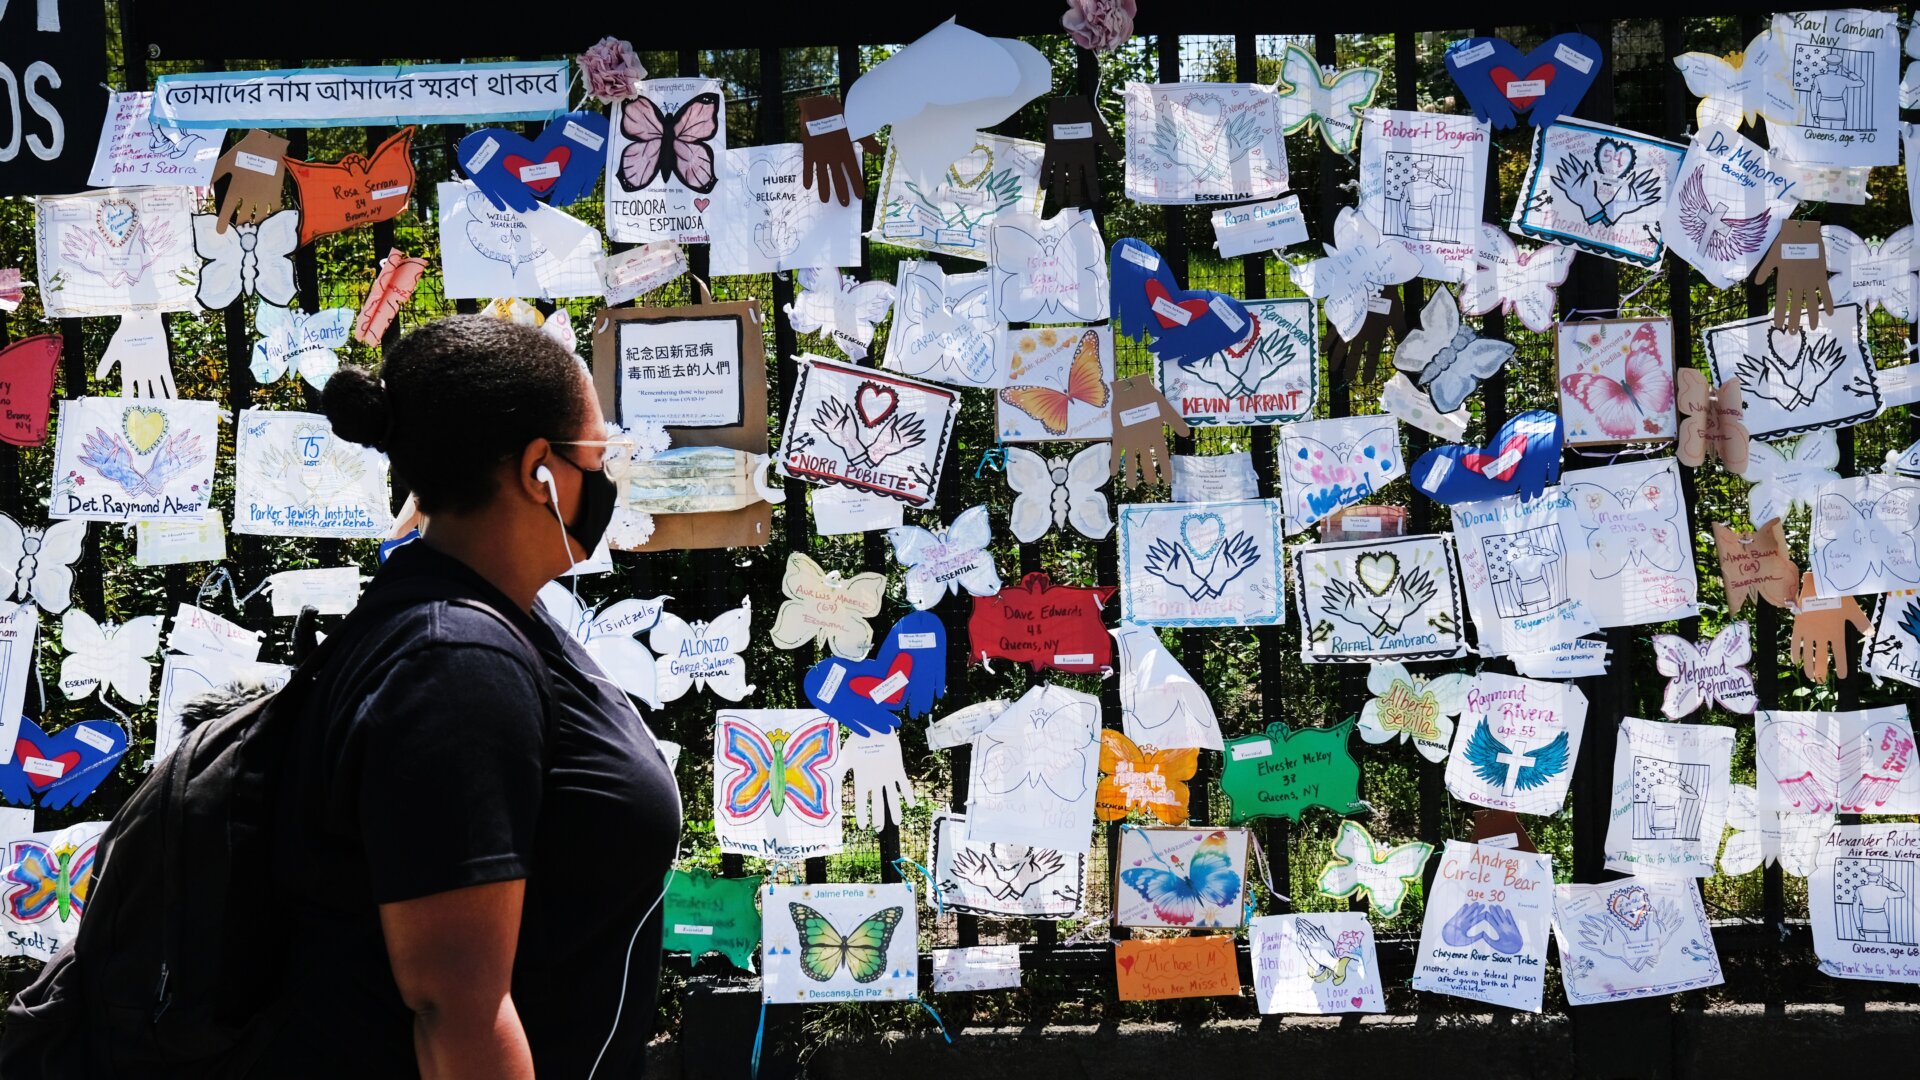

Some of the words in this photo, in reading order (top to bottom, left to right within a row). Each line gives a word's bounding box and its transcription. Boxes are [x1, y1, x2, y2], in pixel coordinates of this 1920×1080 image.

[1793, 12, 1827, 34] Raul
[1834, 18, 1884, 40] Cambian
[1810, 33, 1840, 48] Navy
[166, 80, 262, 106] তোমাদের
[268, 81, 311, 104] নাম
[316, 77, 415, 102] আমাদের
[419, 74, 478, 99] স্মরণ
[488, 70, 560, 96] থাকবে
[1382, 119, 1432, 140] Robert
[1838, 132, 1855, 144] age
[1858, 132, 1876, 143] 70
[112, 163, 134, 174] John
[1603, 149, 1624, 169] 54
[763, 175, 797, 184] HUBERT
[1720, 163, 1757, 188] Brooklyn
[1729, 143, 1797, 200] Mahoney
[332, 186, 359, 200] Rosa
[364, 180, 398, 193] Serrano
[756, 192, 797, 202] BELGRAVE
[1194, 193, 1254, 202] ESSENTIAL
[612, 198, 667, 216] TEODORA
[650, 216, 704, 232] ESPINOSA
[1224, 211, 1250, 228] Raza
[302, 323, 346, 342] Asante
[910, 329, 942, 355] CAROL
[282, 344, 325, 362] ESSENTIAL
[626, 342, 714, 362] 紀念因新冠病
[628, 360, 731, 381] 毒而逝去的人們
[1182, 396, 1230, 416] KEVIN
[1235, 390, 1303, 414] TARRANT
[298, 436, 325, 458] 75
[799, 454, 836, 474] NORA
[845, 464, 909, 490] POBLETE
[68, 494, 102, 514] Det.
[102, 492, 160, 518] Raymond
[164, 499, 201, 514] Abear
[250, 504, 282, 521] Parker
[285, 504, 320, 520] Jewish
[324, 505, 366, 519] Institute
[1462, 508, 1510, 528] Donald
[1598, 510, 1637, 526] Marc
[1722, 552, 1750, 564] MARK
[936, 564, 979, 583] ESSENTIAL
[594, 606, 656, 634] Tsintzelis
[1004, 607, 1036, 621] Dave
[1040, 606, 1083, 618] Edwards
[678, 636, 729, 659] ALONZO
[999, 637, 1042, 653] Queens,
[1044, 639, 1060, 650] NY
[689, 670, 730, 678] ESENCIAL
[1674, 661, 1730, 684] Mehmood
[64, 678, 100, 688] ESSENTIAL
[1380, 687, 1434, 718] Alberto
[1467, 684, 1526, 713] Raymond
[1386, 708, 1437, 736] Sevilla
[1500, 702, 1559, 726] Rivera
[1497, 726, 1516, 737] age
[1519, 725, 1536, 737] 55
[1257, 758, 1298, 776] Elvester
[1303, 752, 1332, 766] McKoy
[1258, 789, 1298, 803] Queens,
[1303, 784, 1320, 797] NY
[1468, 792, 1517, 810] Queens
[721, 835, 758, 852] Anna
[762, 838, 828, 855] Messina
[1825, 832, 1883, 848] Alexander
[1470, 850, 1518, 870] Andrea
[1616, 850, 1640, 862] Thank
[1848, 848, 1863, 856] Air
[1865, 849, 1892, 858] Force,
[1442, 860, 1492, 884] Circle
[1503, 866, 1541, 892] Bear
[814, 888, 838, 898] Jaime
[840, 888, 864, 898] Peña
[1466, 890, 1484, 900] age
[1487, 890, 1506, 902] 30
[7, 930, 46, 952] Scott
[1852, 942, 1890, 956] Queens,
[1890, 948, 1904, 958] age
[1906, 947, 1920, 957] 68
[1146, 952, 1200, 974] Michael
[1432, 948, 1468, 961] Cheyenne
[1470, 948, 1490, 961] River
[1492, 952, 1512, 964] Sioux
[1514, 954, 1538, 966] Tribe
[1188, 976, 1228, 990] Missed
[1452, 966, 1468, 976] dies
[1483, 969, 1508, 980] federal
[1514, 974, 1536, 986] prison
[1459, 978, 1478, 988] giving
[1480, 979, 1498, 988] birth
[866, 988, 882, 997] Paz
[1326, 988, 1348, 998] love
[1358, 984, 1375, 995] and
[1328, 999, 1347, 1011] you
